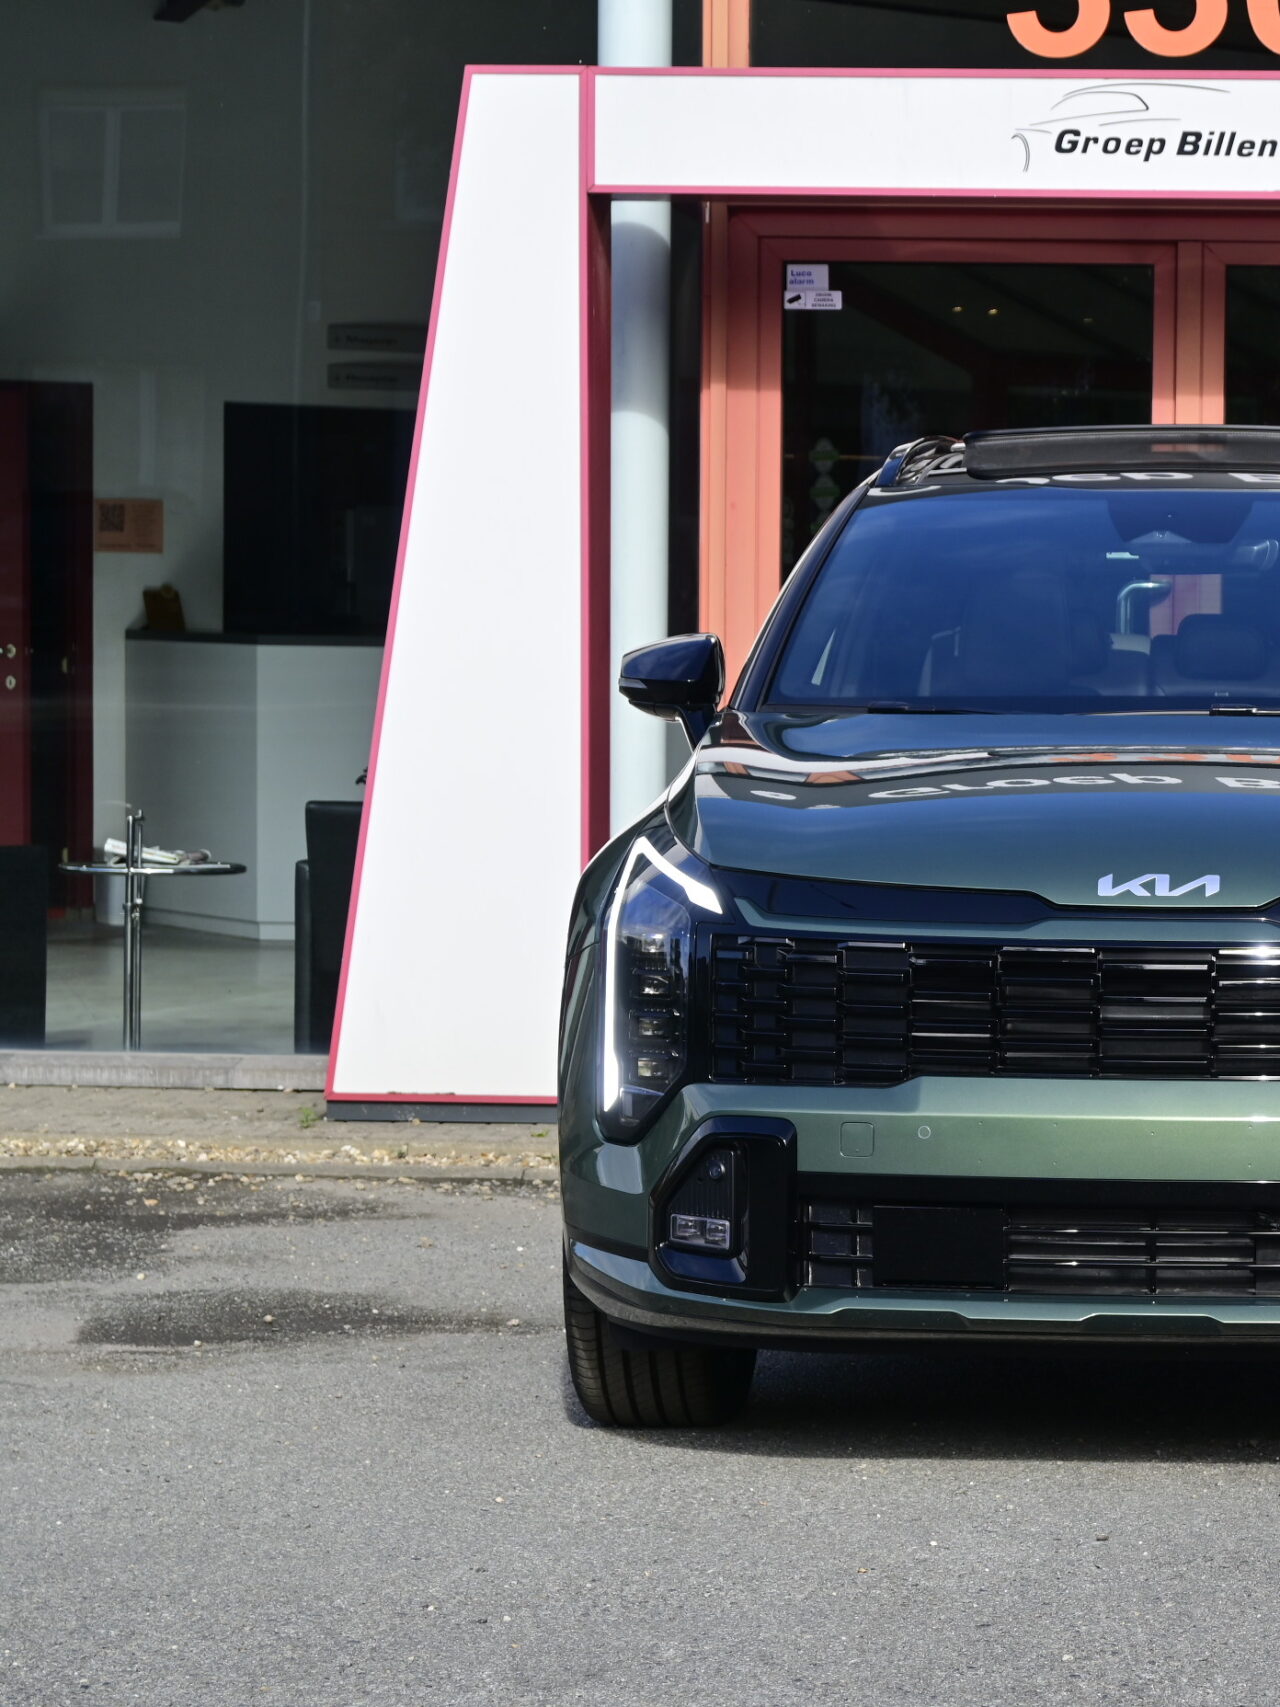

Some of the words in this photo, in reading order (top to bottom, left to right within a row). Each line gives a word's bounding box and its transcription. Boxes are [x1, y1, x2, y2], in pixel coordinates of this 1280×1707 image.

[1054, 128, 1166, 162] Groep
[1176, 131, 1279, 158] Billen
[1097, 873, 1221, 898] KIA
